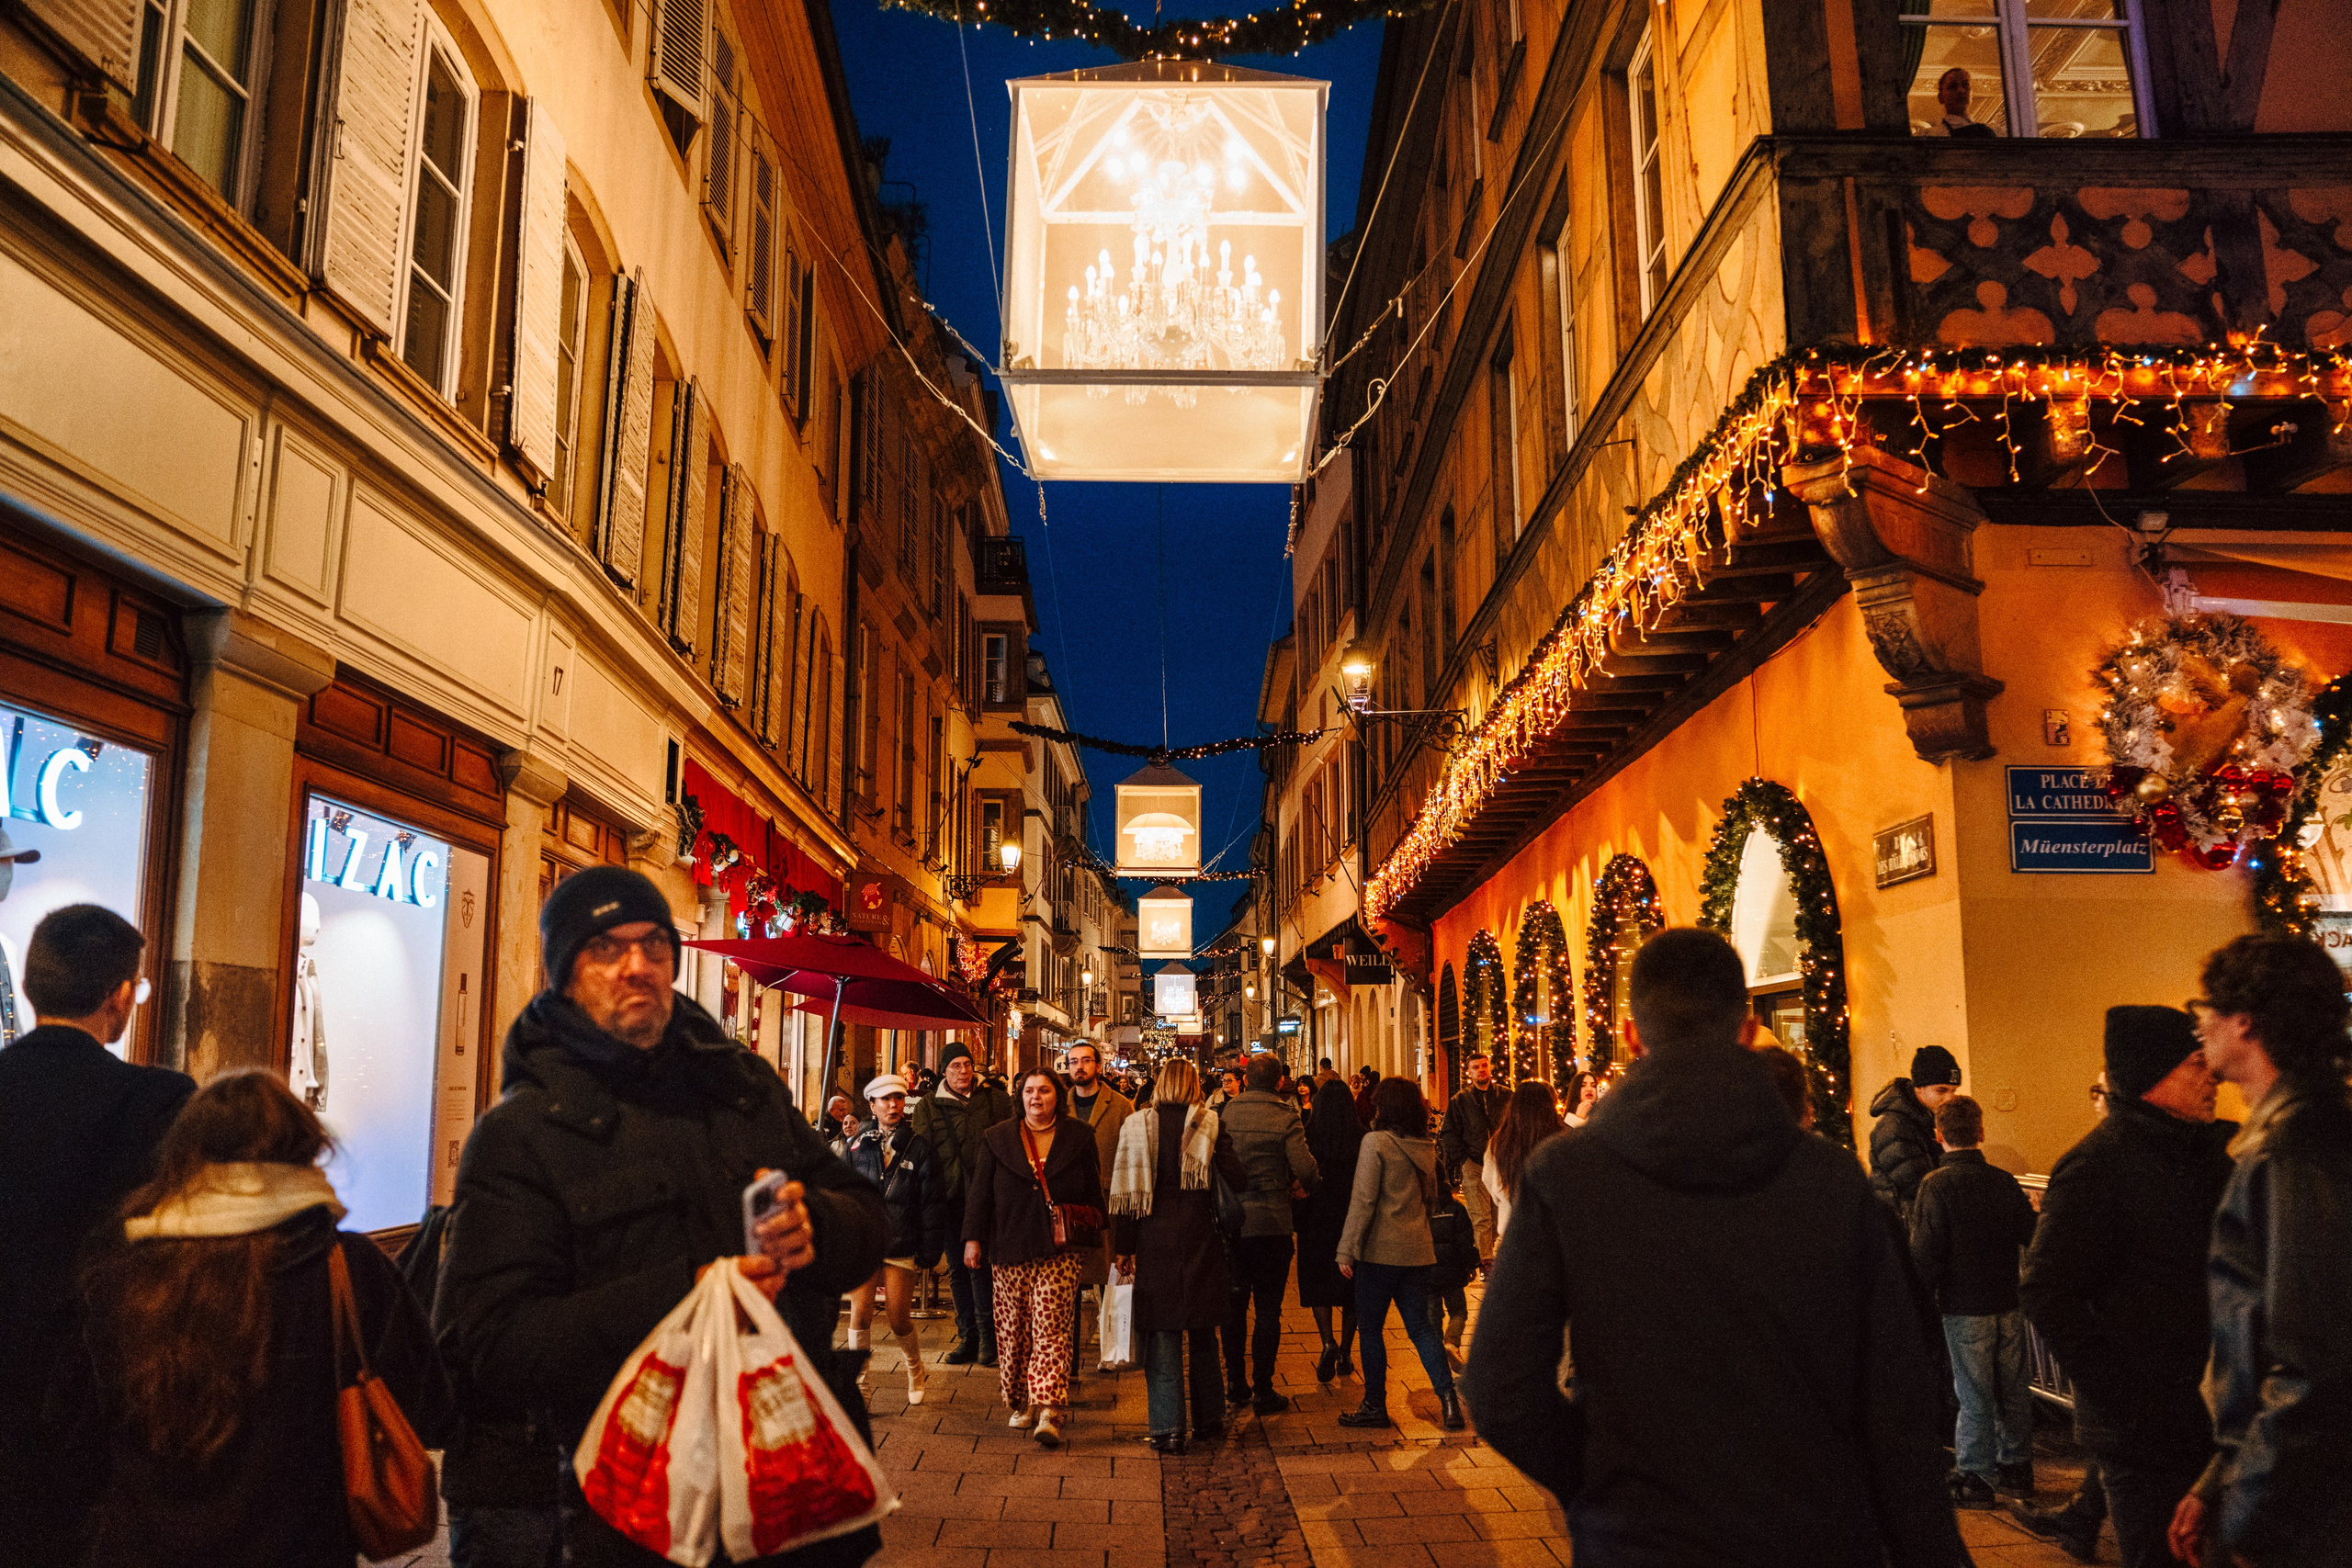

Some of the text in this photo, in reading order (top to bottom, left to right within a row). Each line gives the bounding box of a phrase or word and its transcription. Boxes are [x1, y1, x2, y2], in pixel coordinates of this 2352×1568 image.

[552, 665, 564, 696] 17
[0, 725, 94, 830] C
[2041, 774, 2089, 789] PLACE
[2015, 795, 2119, 809] LA CATHEDR
[2020, 839, 2149, 858] Müensterplatz
[310, 818, 439, 908] IZAC
[1345, 954, 1391, 966] WEILL
